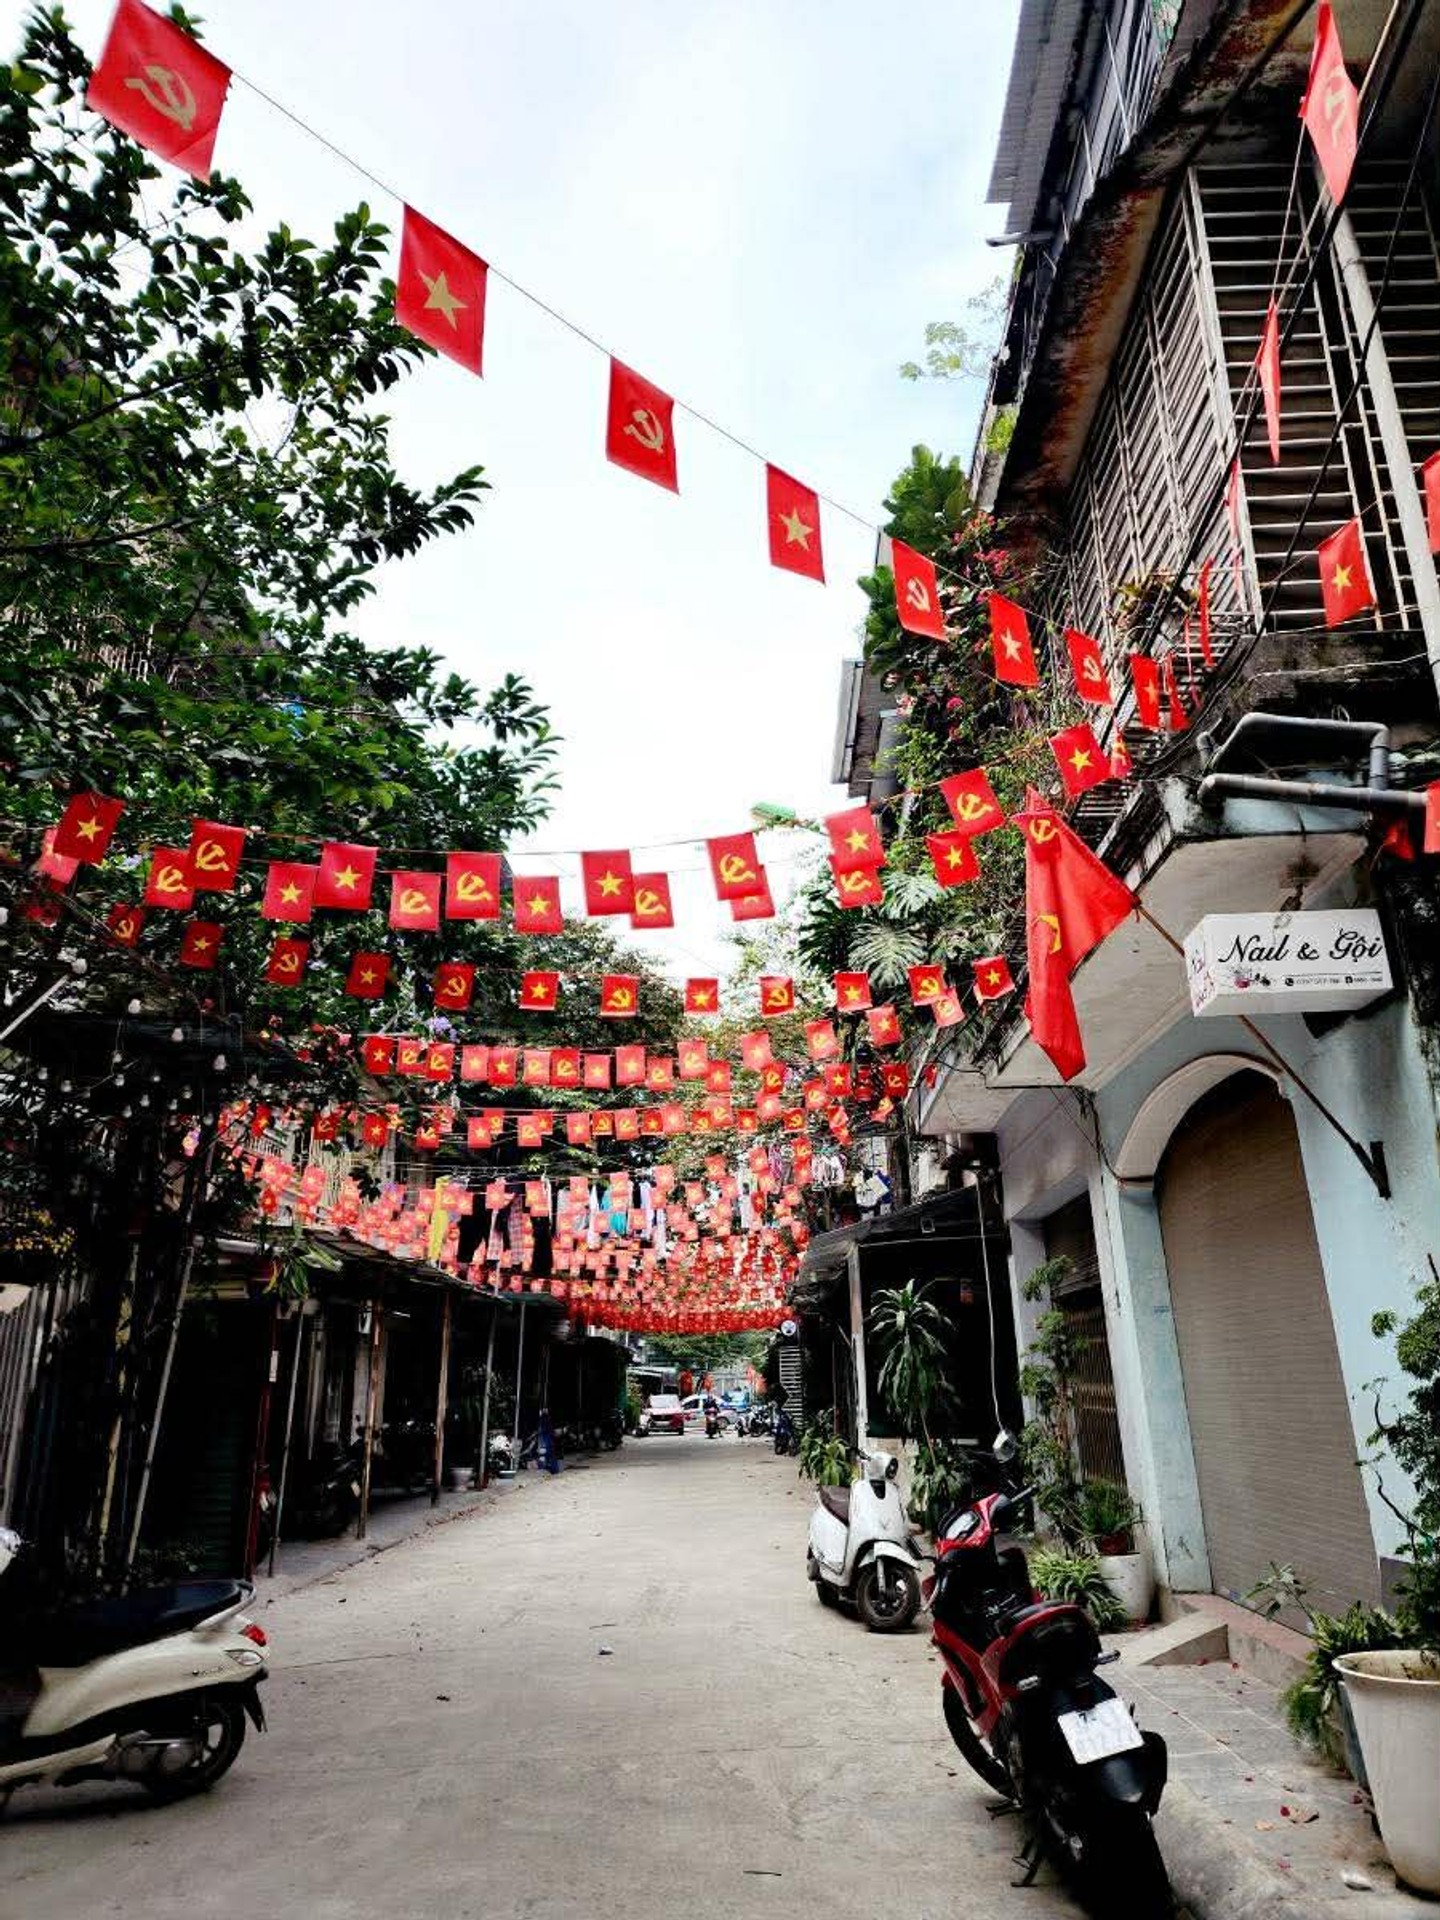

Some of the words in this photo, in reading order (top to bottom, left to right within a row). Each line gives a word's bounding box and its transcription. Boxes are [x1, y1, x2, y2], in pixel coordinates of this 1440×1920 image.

[1218, 934, 1290, 962] Nail
[1297, 942, 1320, 961] &
[1329, 928, 1383, 963] Gội
